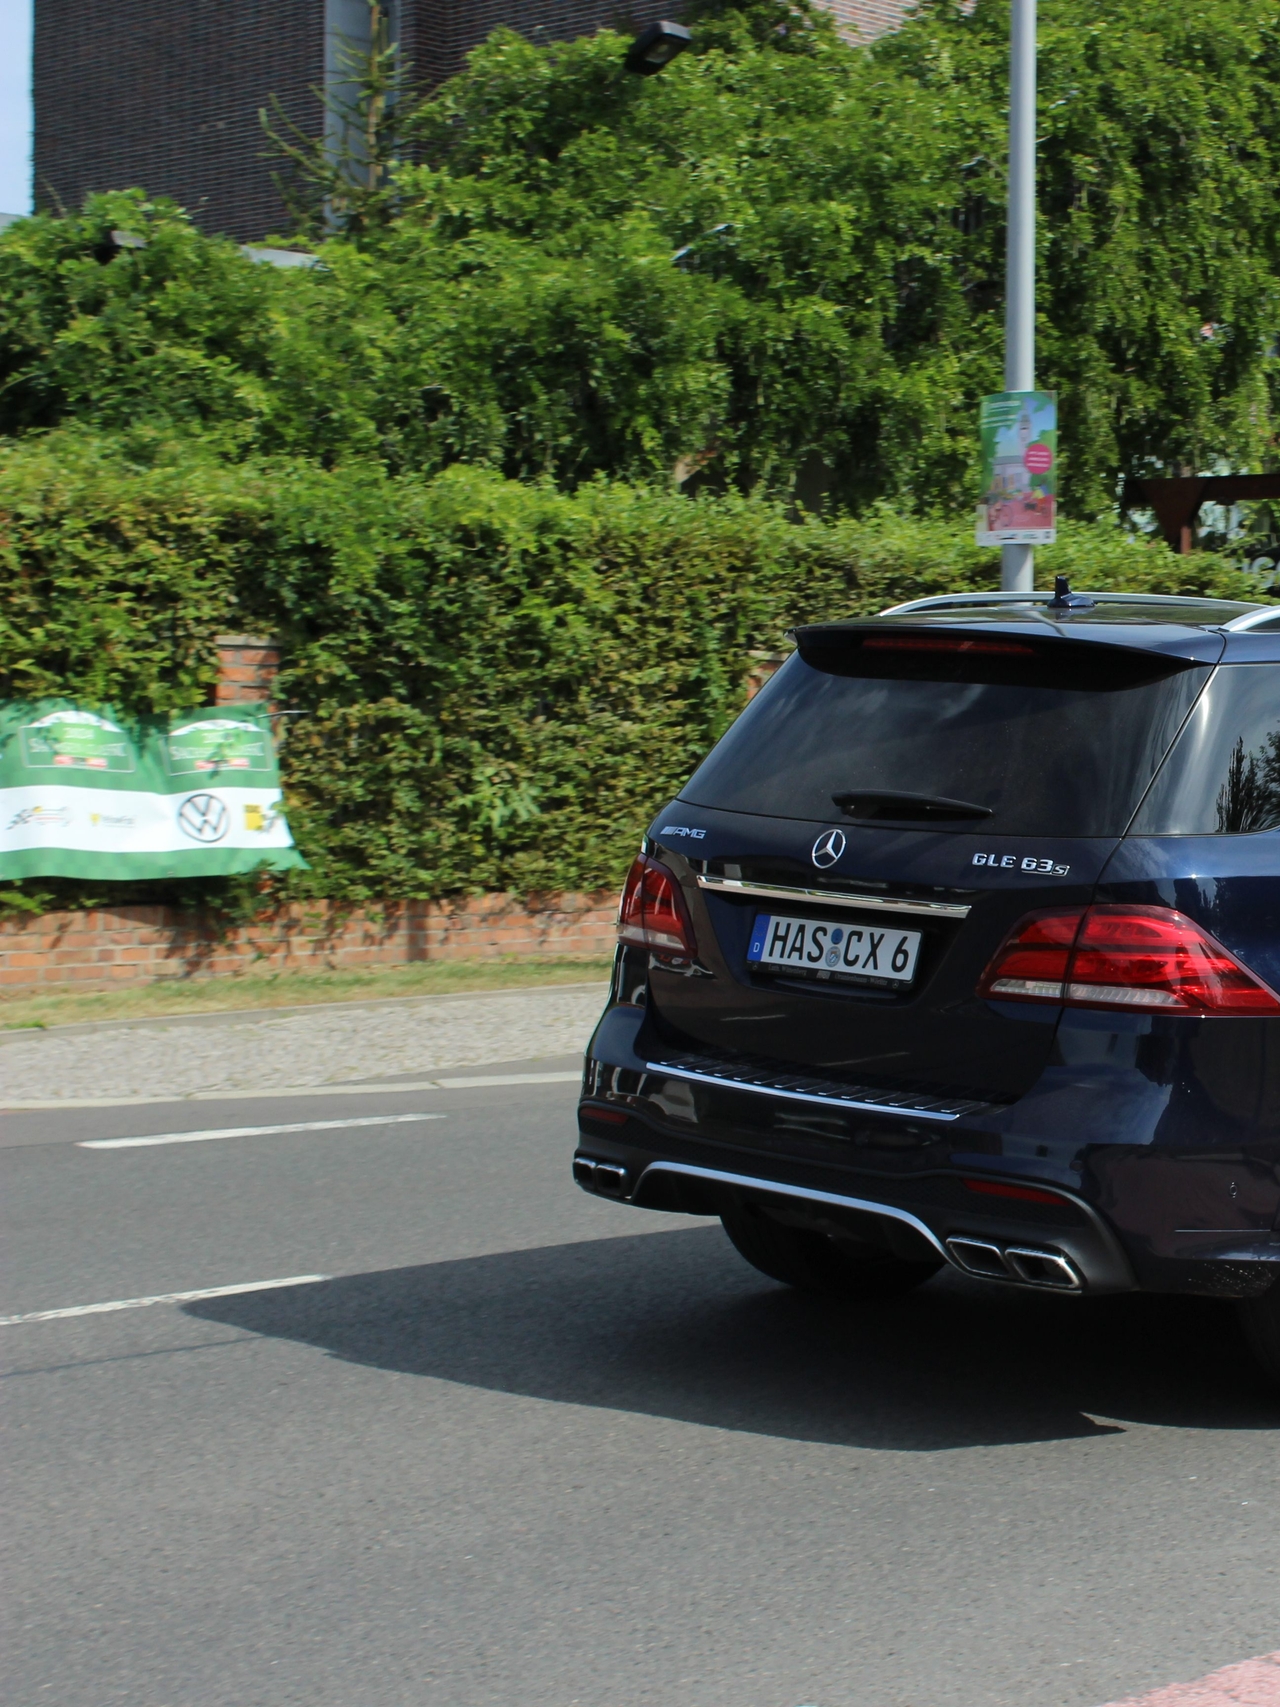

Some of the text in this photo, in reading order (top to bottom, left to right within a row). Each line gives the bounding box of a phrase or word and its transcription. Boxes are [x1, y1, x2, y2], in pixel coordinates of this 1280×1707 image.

[672, 826, 707, 839] AMG
[972, 853, 1017, 868] GLE
[752, 921, 909, 973] D HAS CX 6
